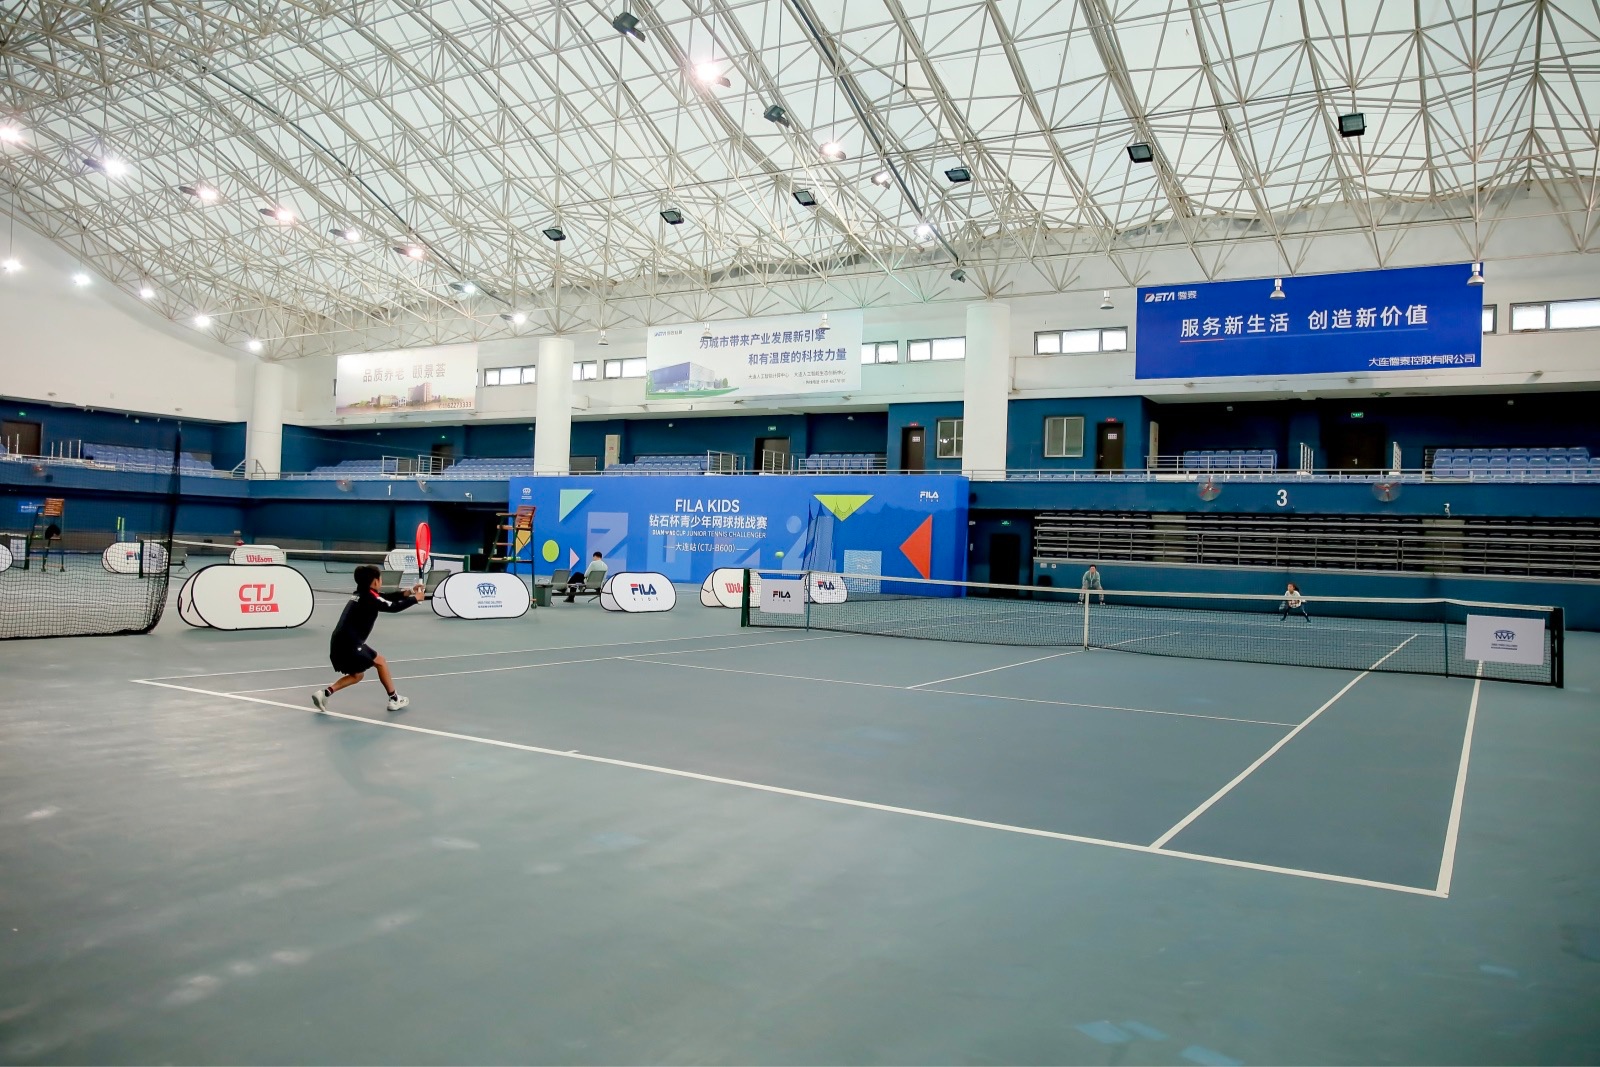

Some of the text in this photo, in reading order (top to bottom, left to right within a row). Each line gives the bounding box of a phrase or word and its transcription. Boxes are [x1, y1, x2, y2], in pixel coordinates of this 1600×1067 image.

[1180, 304, 1428, 338] 服务新生活 创造新价值
[700, 328, 826, 349] 为城市带来产业发展新引擎
[748, 348, 847, 366] 和有温度的科技力量
[363, 367, 405, 383] 品质养老
[387, 484, 392, 496] 1
[919, 491, 939, 499] FILA
[1276, 489, 1288, 507] 3
[675, 499, 740, 513] FILA KIDS
[649, 514, 768, 530] 钻石杯青少年网球挑战赛
[686, 530, 707, 538] JUNIOR
[708, 530, 728, 538] TENNIS
[729, 530, 767, 539] CHALLENGER
[246, 554, 273, 563] Wilson
[630, 583, 657, 595] FILA
[817, 580, 835, 590] FILA
[238, 583, 275, 602] CTJ
[772, 590, 791, 598] FILA
